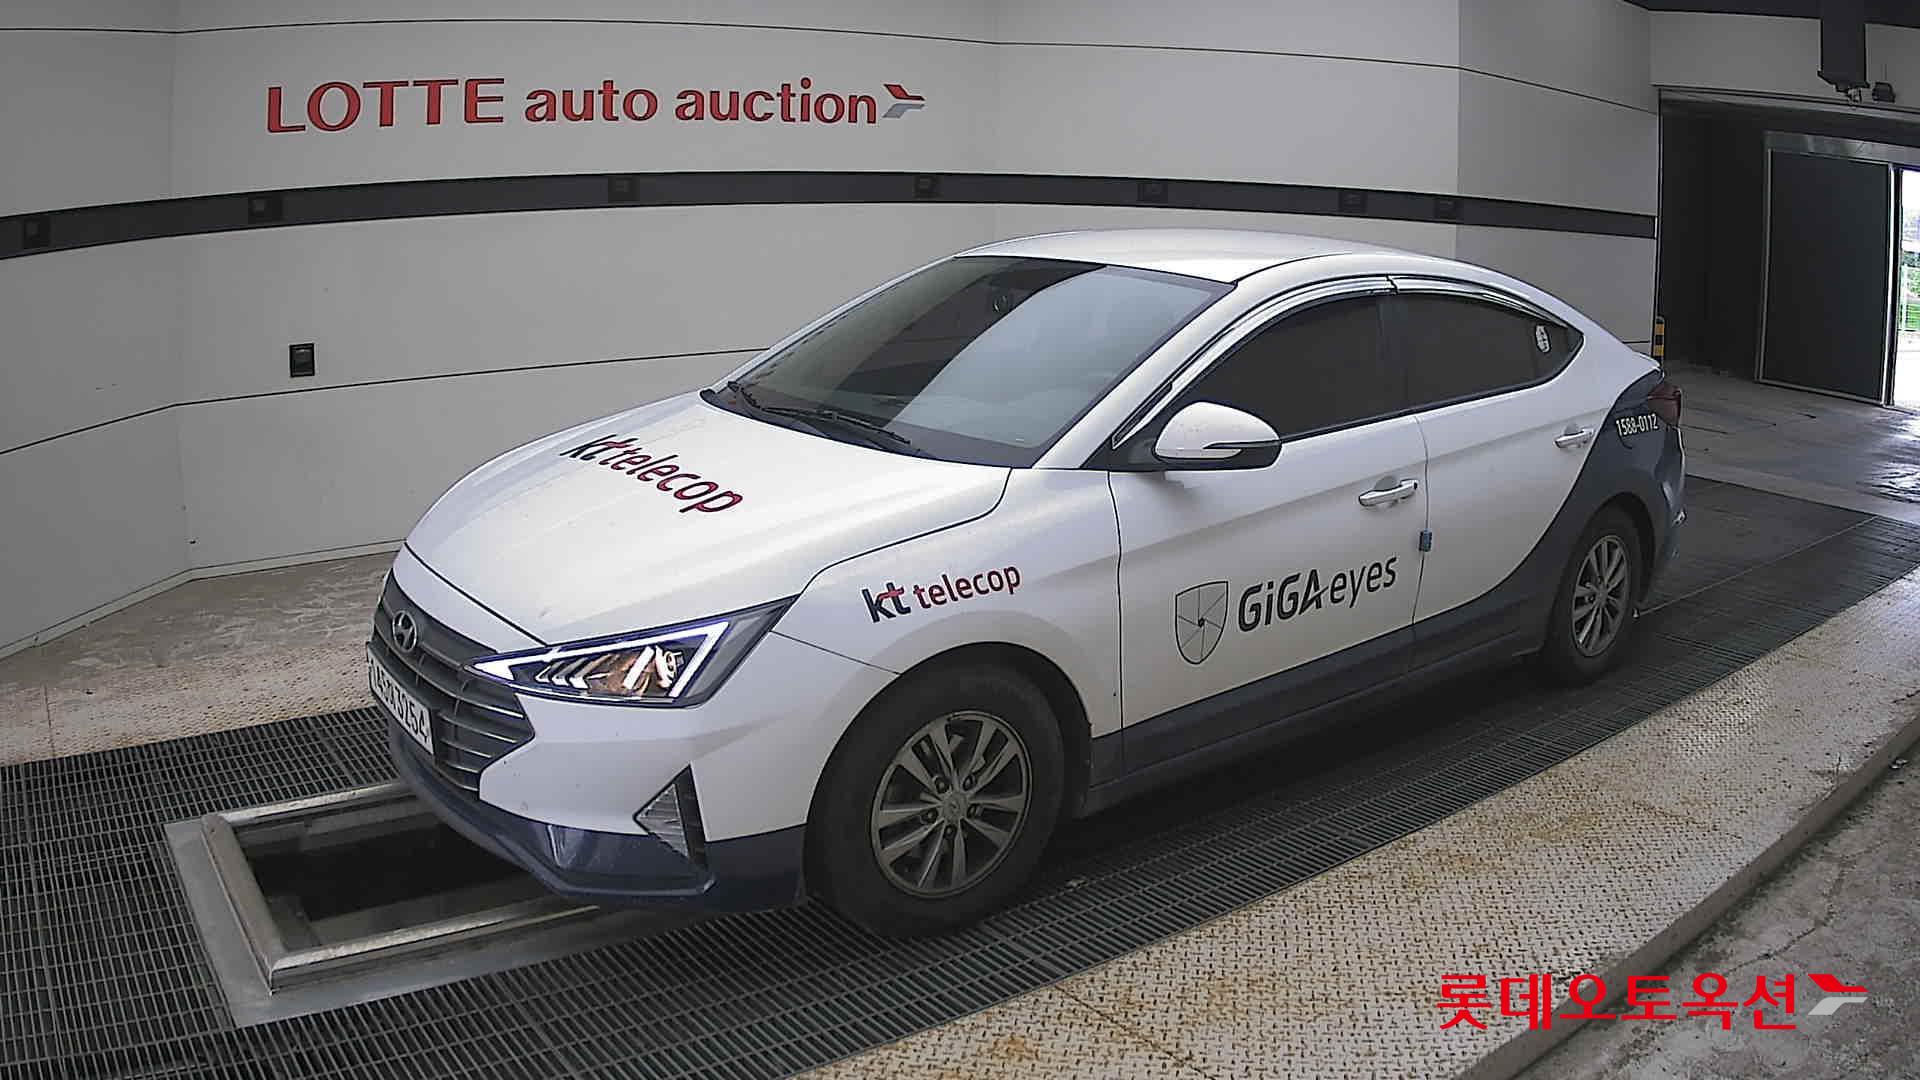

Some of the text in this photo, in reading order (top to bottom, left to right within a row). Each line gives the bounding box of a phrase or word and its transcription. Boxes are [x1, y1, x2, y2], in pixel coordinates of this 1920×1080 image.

[267, 78, 878, 133] LOTTE auto auction
[1615, 413, 1660, 437] 1588-0112
[559, 434, 744, 514] kt telecop
[862, 562, 1022, 623] kt telecop
